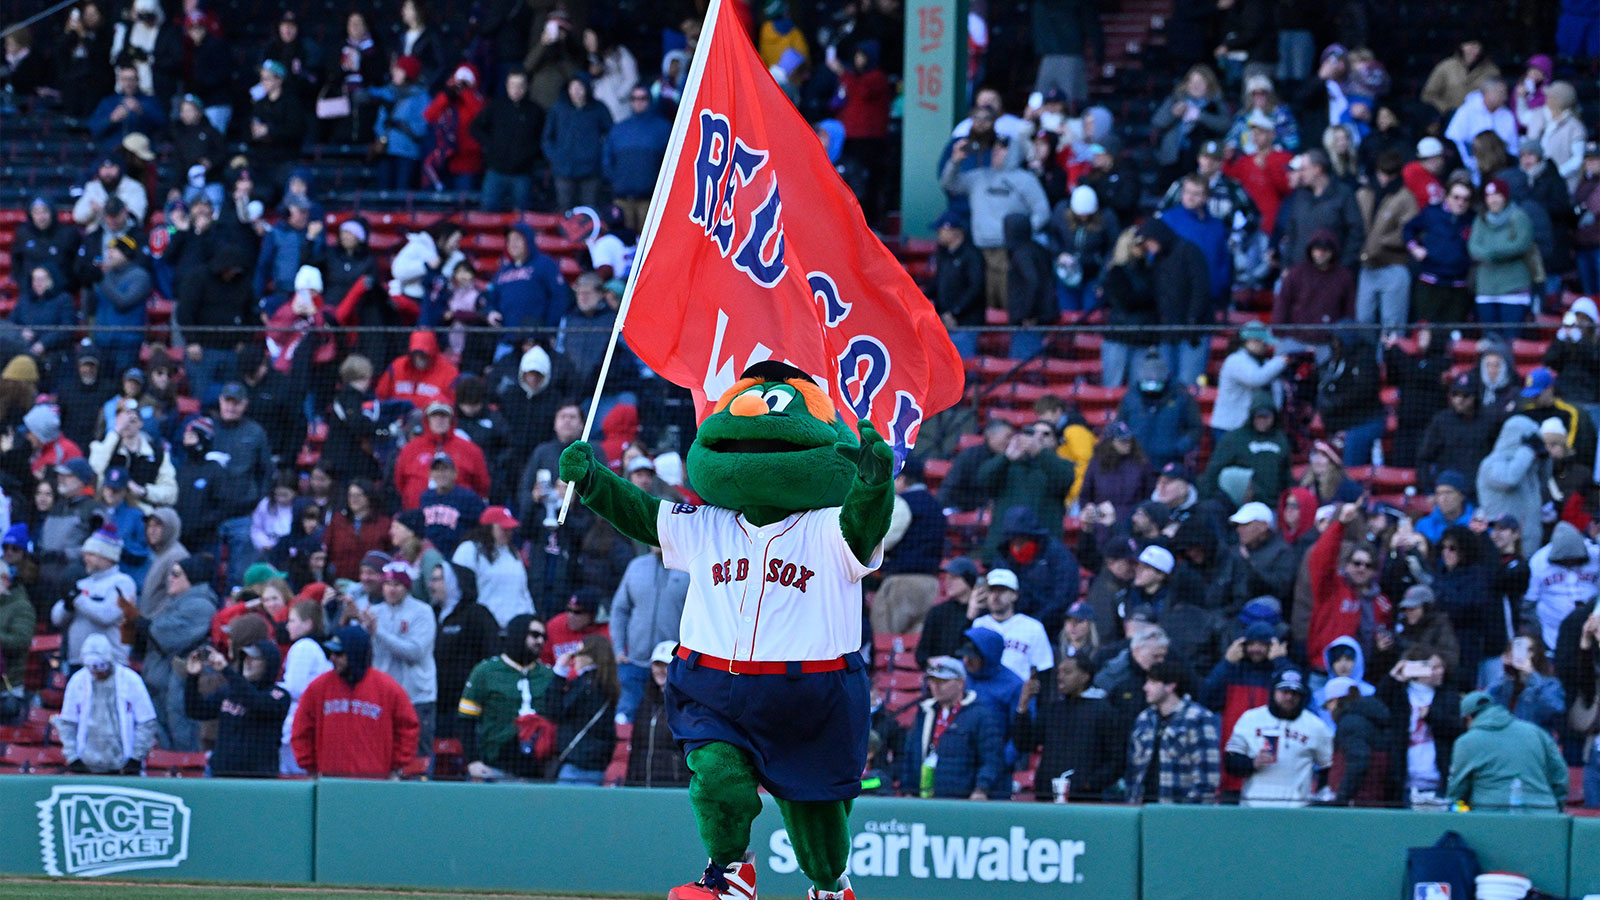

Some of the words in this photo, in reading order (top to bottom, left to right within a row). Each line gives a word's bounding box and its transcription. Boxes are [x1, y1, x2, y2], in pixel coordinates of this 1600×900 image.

[917, 6, 945, 41] 15
[916, 64, 943, 98] 16
[689, 108, 789, 288] RED
[711, 557, 749, 587] RED
[765, 558, 814, 594] SOX
[323, 698, 382, 721] BOSTON
[71, 795, 174, 839] ACE
[73, 836, 173, 866] TICKET
[768, 822, 1086, 883] sartwater
